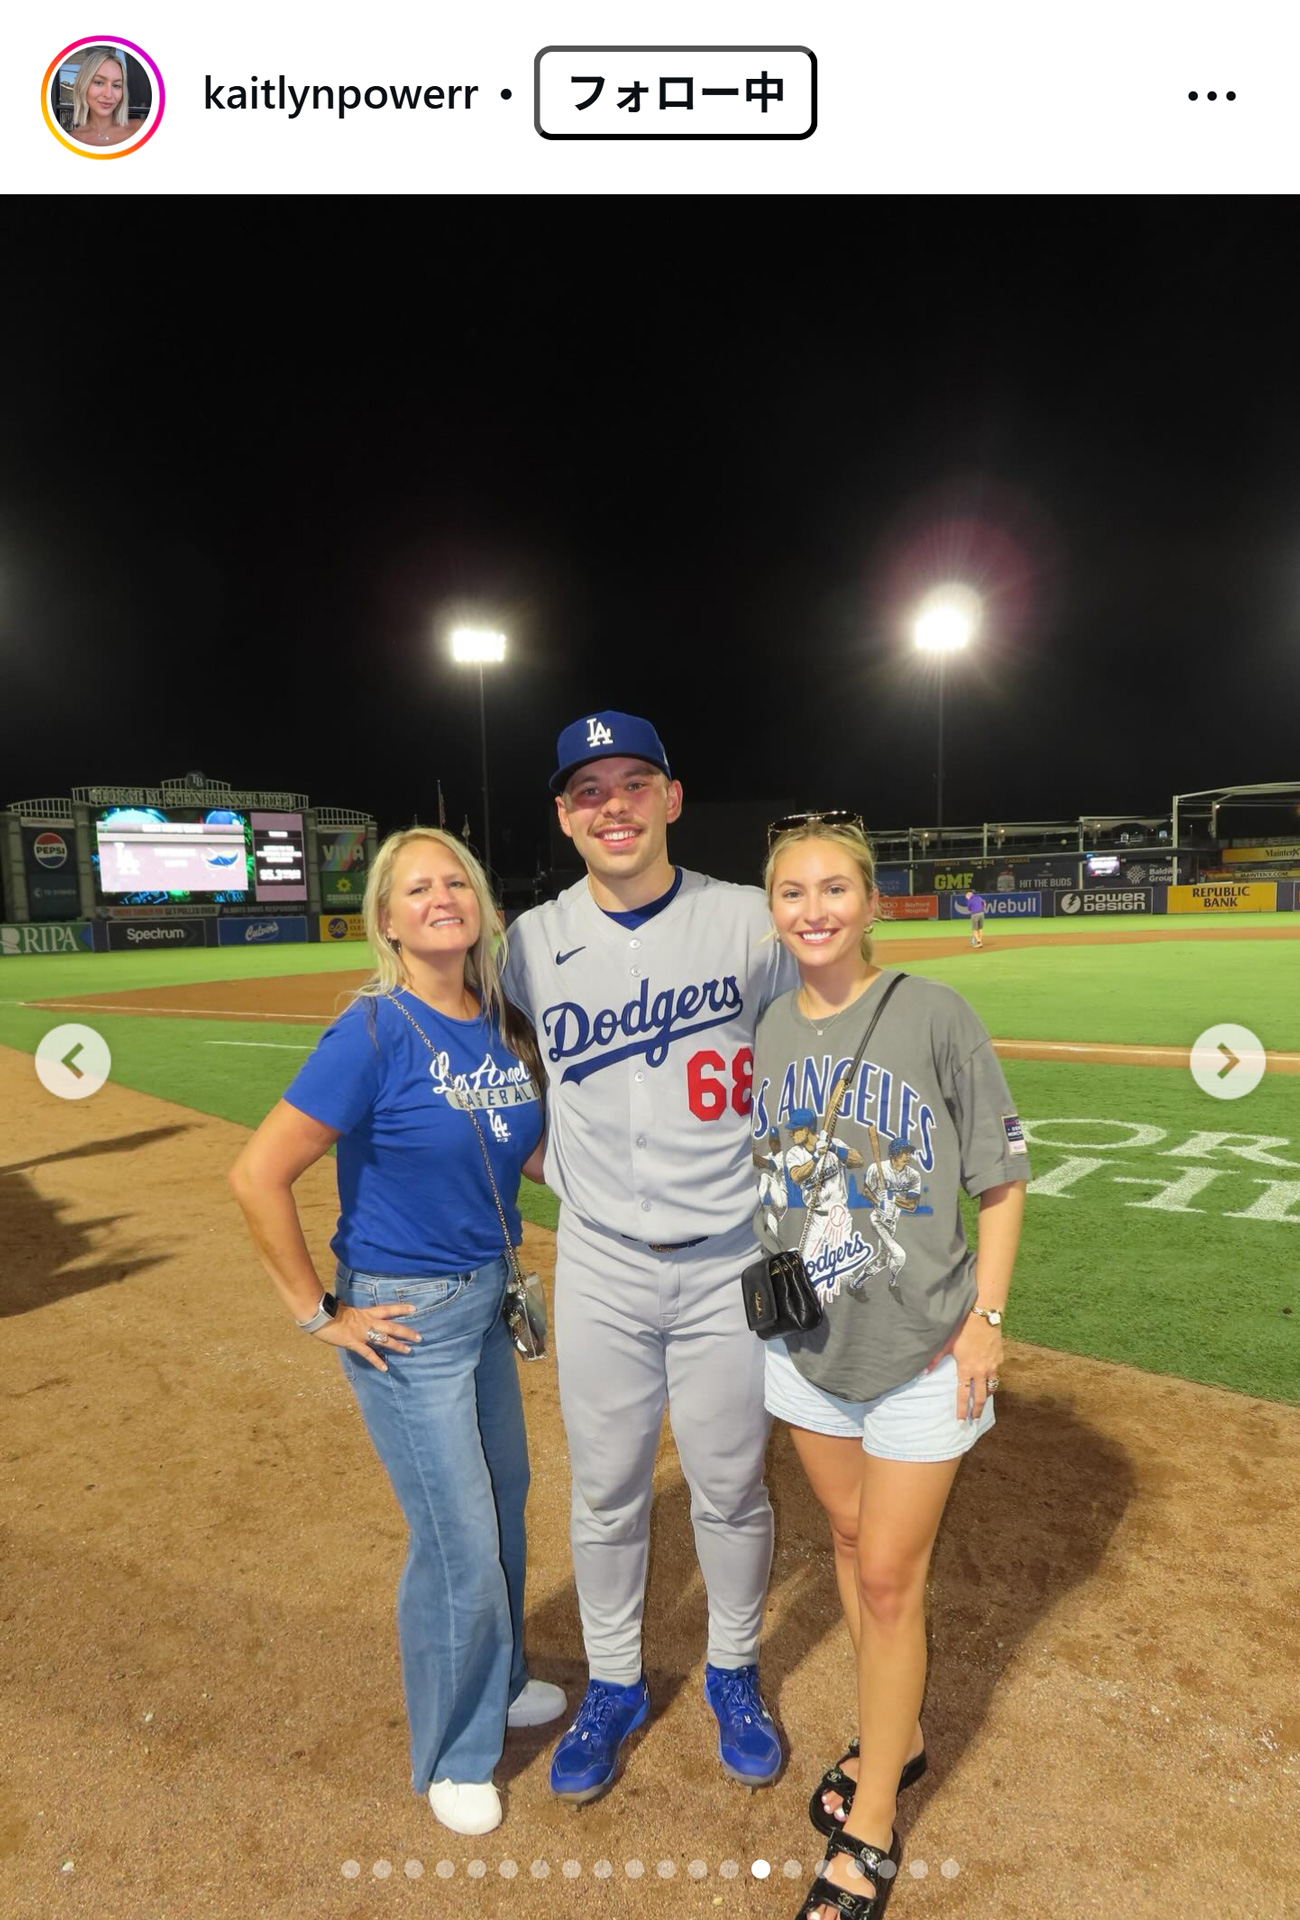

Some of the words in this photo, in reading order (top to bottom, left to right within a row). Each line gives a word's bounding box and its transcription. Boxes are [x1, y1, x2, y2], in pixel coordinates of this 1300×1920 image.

[586, 718, 614, 748] LA
[36, 846, 66, 855] PEPSI
[322, 845, 364, 860] VIVA
[934, 873, 974, 890] GMF
[1019, 880, 1036, 888] HIT
[1037, 879, 1050, 888] THE
[1051, 877, 1072, 887] BUDS
[1192, 886, 1250, 898] REPUBLIC
[984, 897, 1037, 914] Webull
[1203, 898, 1238, 908] BANK
[21, 926, 80, 953] RIPA
[126, 927, 185, 943] Spectrum
[543, 975, 743, 1070] Dodgers
[429, 1051, 471, 1099] Los
[469, 1053, 531, 1096] Angel
[687, 1046, 753, 1122] 68
[486, 1108, 511, 1138] LA
[805, 1232, 872, 1290] odgers
